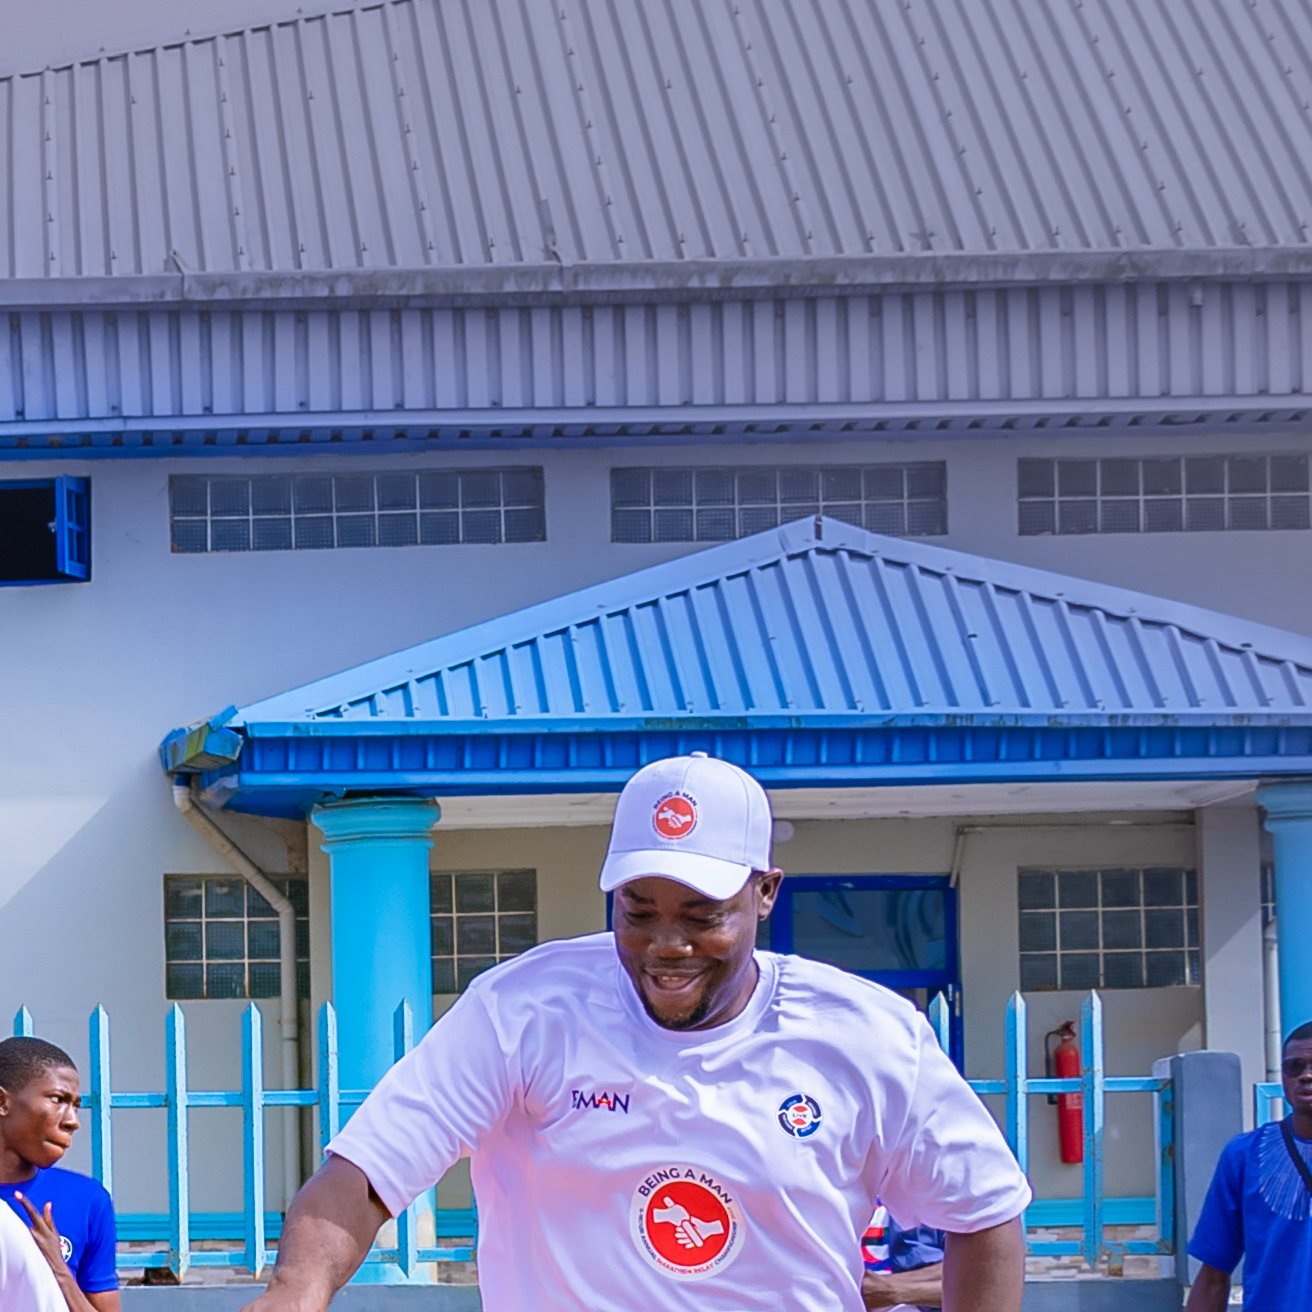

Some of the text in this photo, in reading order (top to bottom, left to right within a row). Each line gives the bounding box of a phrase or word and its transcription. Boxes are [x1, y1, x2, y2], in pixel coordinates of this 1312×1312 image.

[638, 1167, 733, 1204] BEING A MAN
